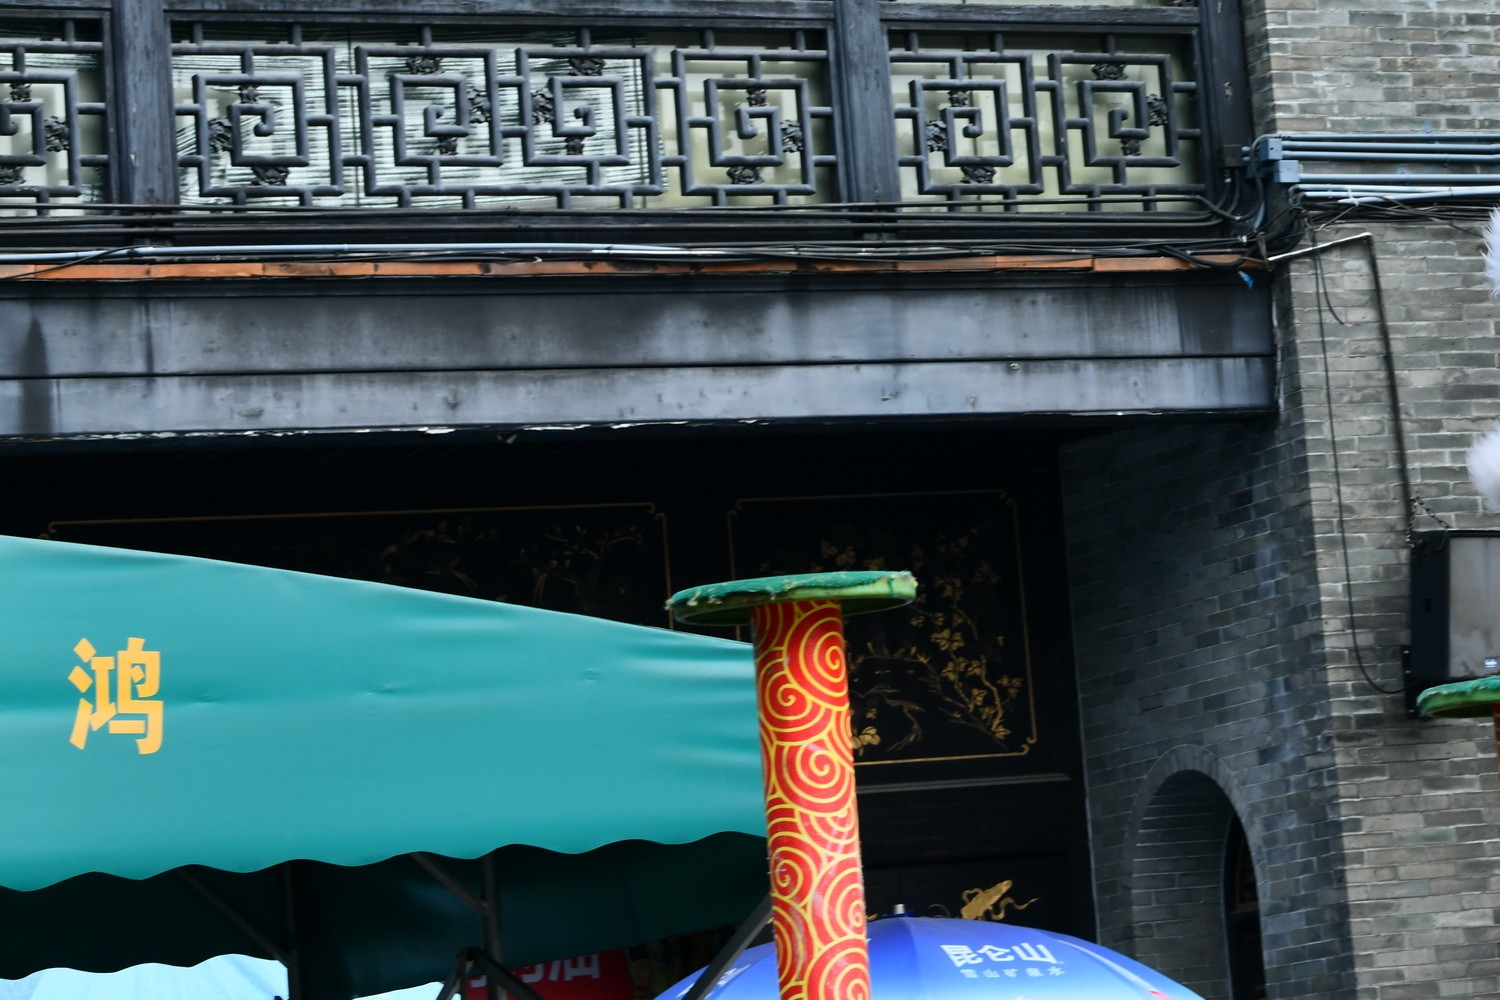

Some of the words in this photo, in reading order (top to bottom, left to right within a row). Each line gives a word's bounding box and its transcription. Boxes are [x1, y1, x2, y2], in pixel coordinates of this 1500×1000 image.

[67, 637, 164, 755] 鸿
[939, 942, 1058, 968] 昆仑山
